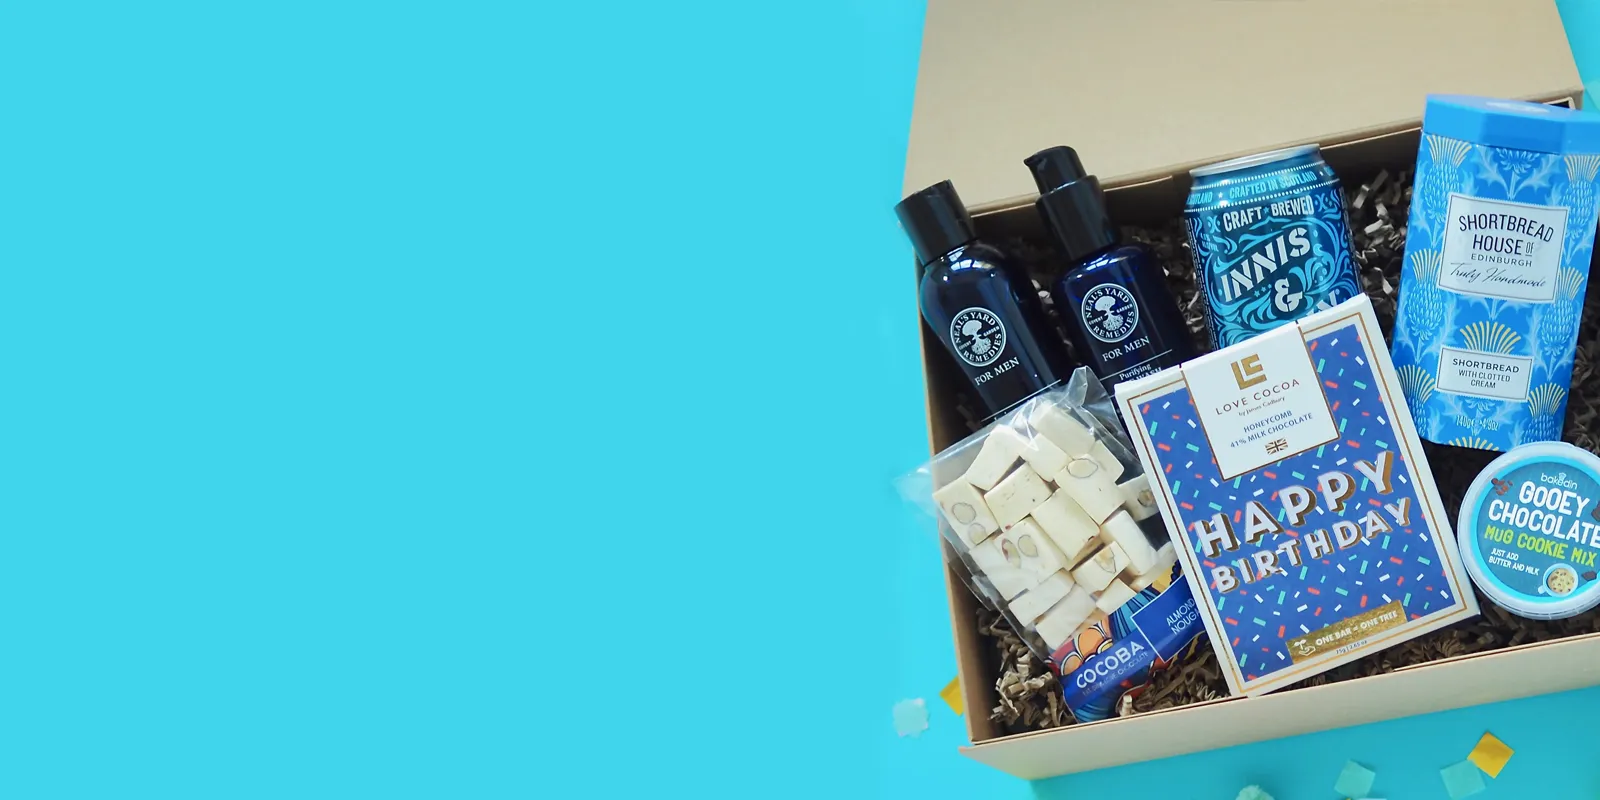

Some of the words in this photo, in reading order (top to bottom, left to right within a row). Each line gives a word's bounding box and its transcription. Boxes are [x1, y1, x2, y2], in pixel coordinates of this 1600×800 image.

[1229, 182, 1267, 200] CRAFTED
[1267, 177, 1279, 192] IN
[1279, 170, 1318, 190] SCOTLAND
[1223, 206, 1262, 232] CRAFT
[1271, 194, 1315, 218] BREWED
[1458, 213, 1554, 243] SHORTBREAD
[1472, 233, 1523, 256] HOUSE
[1220, 227, 1311, 303] INNIS
[1451, 262, 1482, 283] Truly
[1482, 267, 1546, 287] Handmade
[1470, 253, 1533, 268] EDINBURGH
[1085, 289, 1103, 319] NEAL'S
[1104, 287, 1130, 303] YARD
[1274, 277, 1303, 313] &
[954, 315, 969, 344] NEAL'S
[970, 311, 996, 326] YARD
[1093, 310, 1135, 338] REMEDIES
[963, 333, 1002, 362] REMEDIES
[1102, 348, 1123, 362] FOR
[1124, 335, 1150, 353] MEN
[974, 371, 993, 386] FOR
[994, 356, 1020, 376] MEN
[1119, 363, 1151, 380] Purifying
[1452, 358, 1520, 373] SHORTBREAD
[1458, 369, 1479, 378] WITH
[1479, 372, 1511, 383] CLOTTED
[1215, 397, 1248, 416] LOVE
[1253, 378, 1300, 401] COCOA
[1470, 379, 1496, 389] CREAM
[1230, 438, 1247, 448] 41%
[1247, 430, 1267, 442] MILK
[1267, 412, 1314, 435] CHOCOLATE
[1243, 410, 1293, 433] HONEYCOMB
[1195, 450, 1394, 558] HAPPY
[1518, 481, 1590, 518] GOOEY
[1488, 499, 1600, 549] CHOCOLATE
[1211, 497, 1411, 593] BIRTHDAY
[1484, 525, 1514, 544] MUG
[1516, 533, 1569, 560] COOKIE
[1570, 547, 1598, 568] MIX
[1490, 548, 1506, 557] JUST
[1506, 552, 1519, 561] ADD
[1488, 556, 1512, 568] BUTTER
[1512, 563, 1525, 571] AND
[1525, 566, 1540, 576] MILK
[1166, 598, 1195, 627] ALMOND
[1315, 633, 1335, 646] ONE
[1334, 627, 1352, 640] BAR
[1360, 618, 1379, 630] ONE
[1379, 610, 1398, 623] TREE
[1076, 640, 1145, 689] COCOBA
